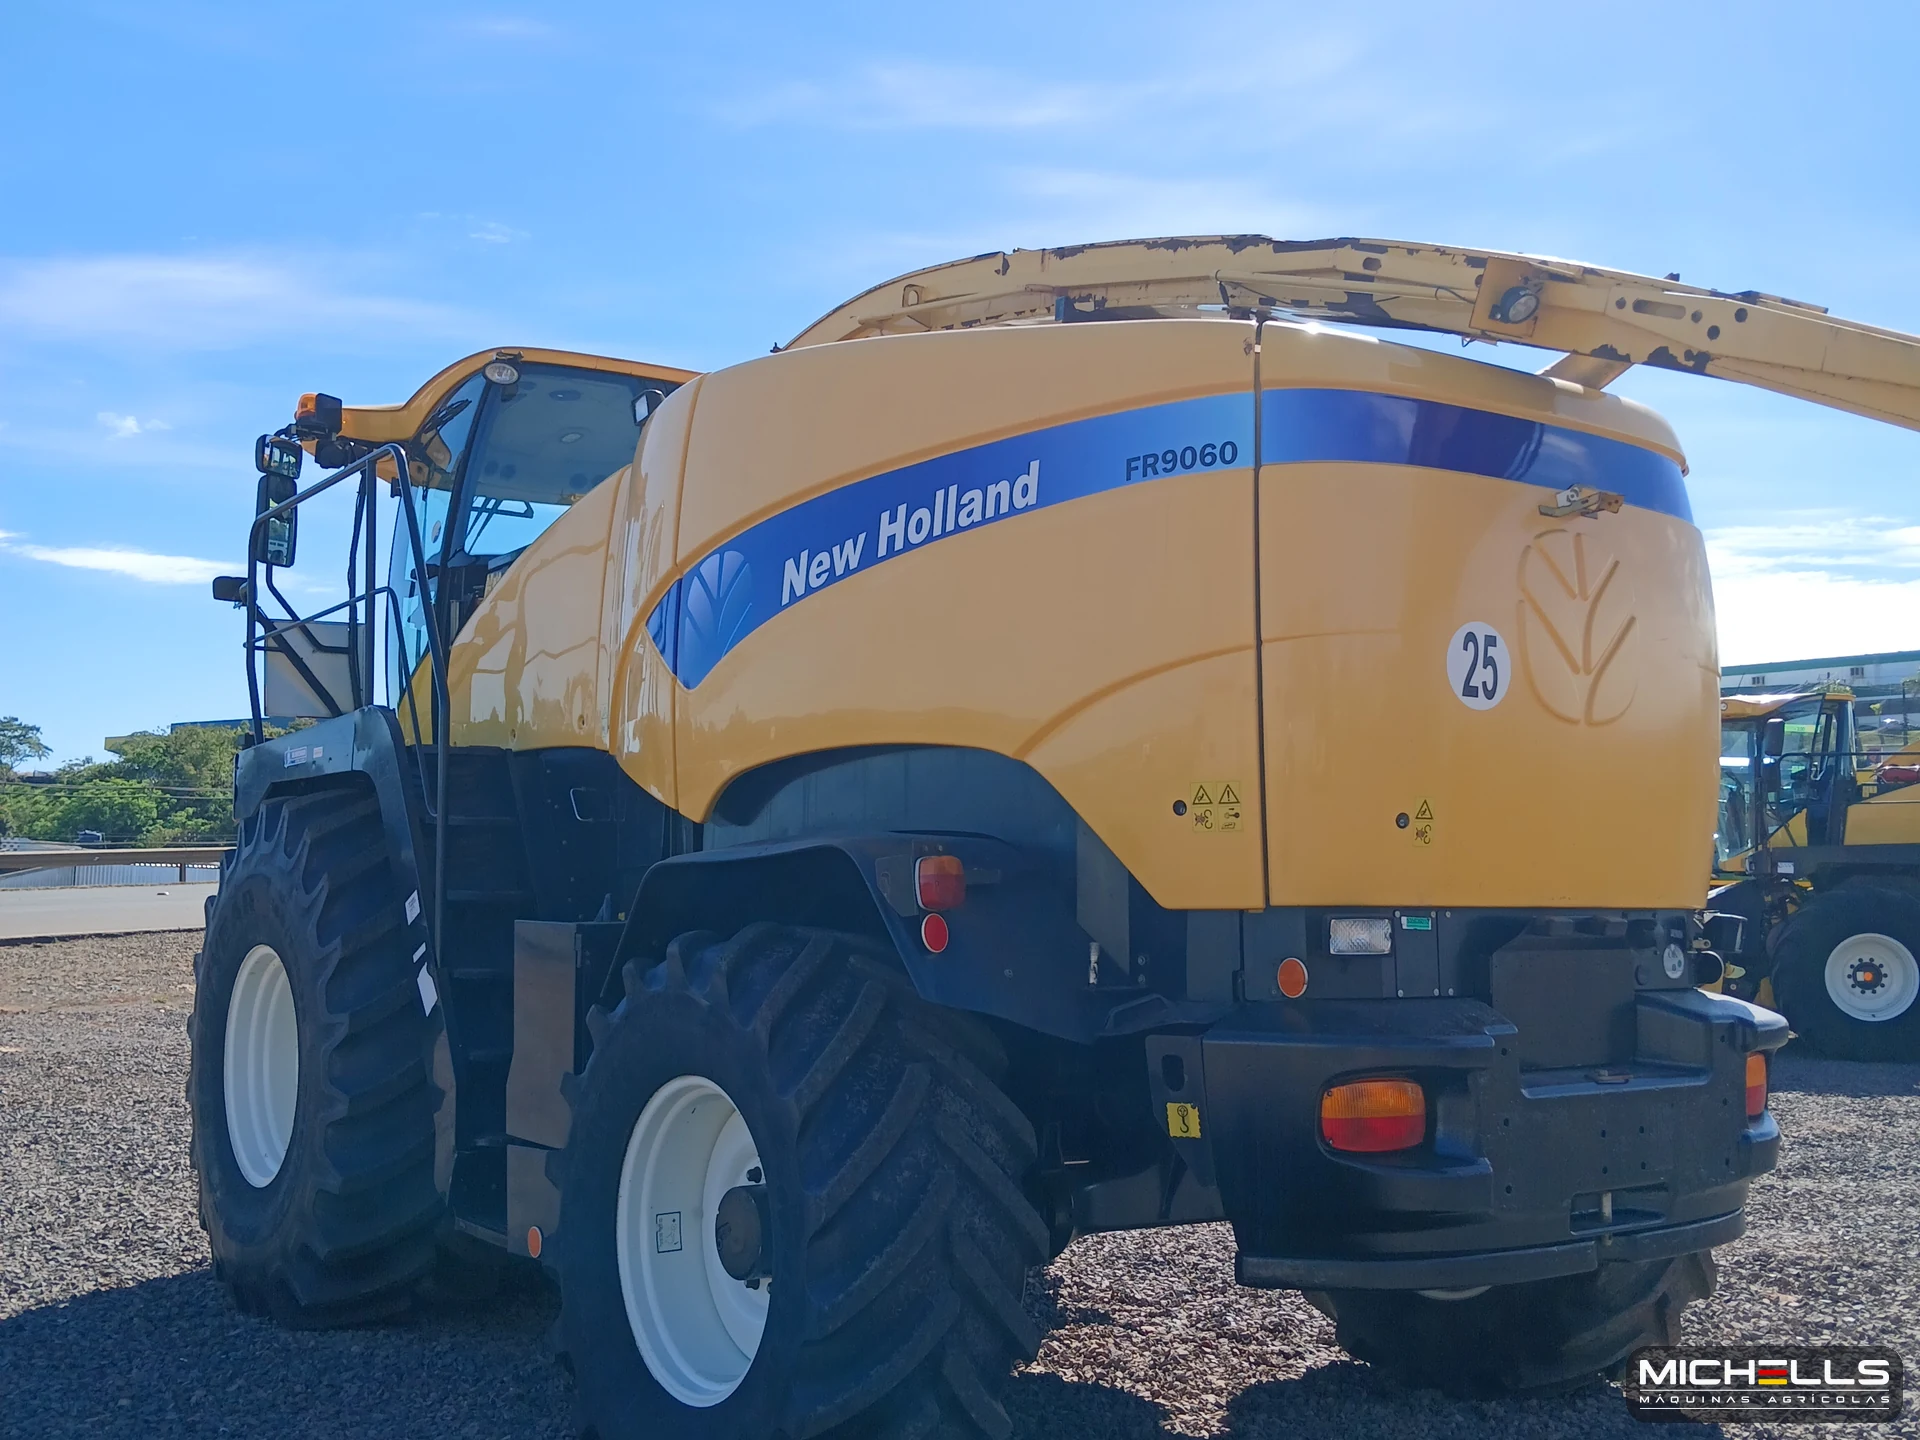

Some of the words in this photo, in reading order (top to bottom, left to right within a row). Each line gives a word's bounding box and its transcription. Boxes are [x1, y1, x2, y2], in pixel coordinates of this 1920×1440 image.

[1126, 440, 1239, 482] FR9060
[780, 532, 867, 606] New
[877, 459, 1041, 558] Holland
[1462, 631, 1498, 700] 25
